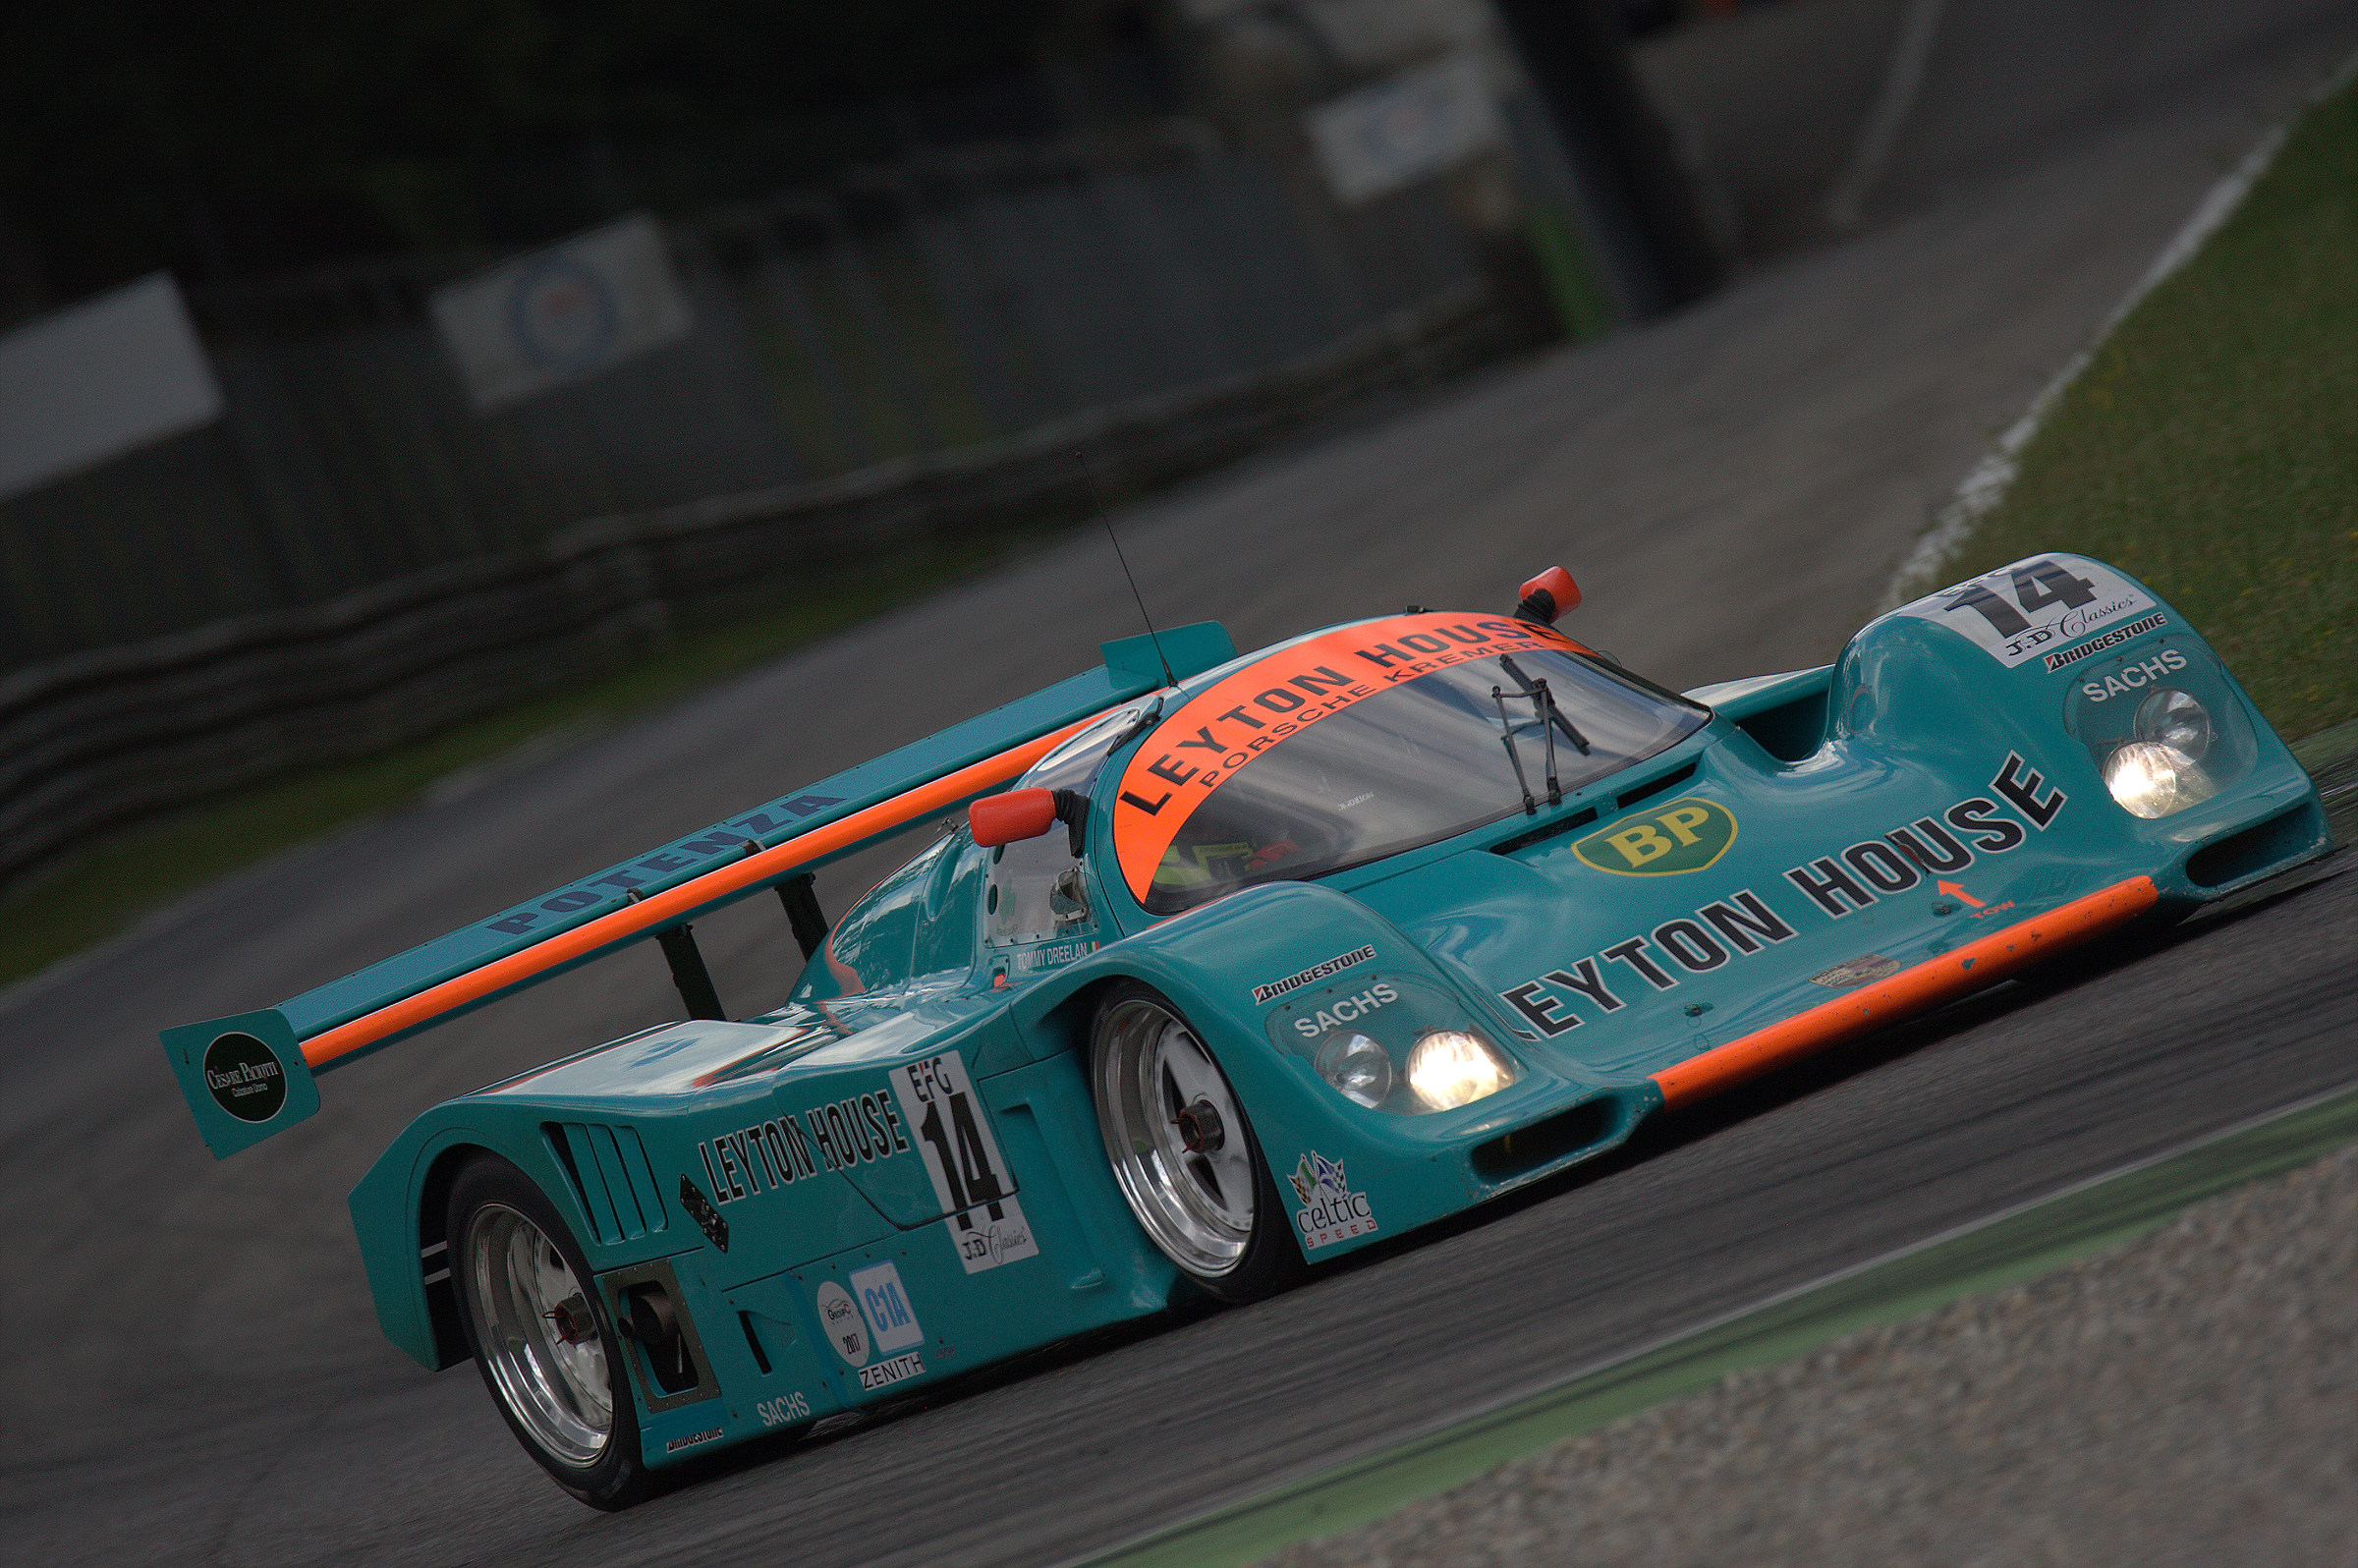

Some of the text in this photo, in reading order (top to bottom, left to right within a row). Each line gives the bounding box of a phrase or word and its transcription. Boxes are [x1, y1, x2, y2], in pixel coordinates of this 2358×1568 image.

[1943, 560, 2098, 640] 14
[2059, 596, 2137, 639] Classics
[2045, 613, 2166, 673] BRIDGESTONE
[2082, 648, 2187, 702] SACHS
[1119, 620, 1569, 816] LEYTON HOUSE
[1198, 641, 1546, 788] PORSCHE KREMER
[1603, 806, 1710, 868] BP
[1782, 749, 2068, 919] HOUSE
[485, 794, 847, 935] POTENZA
[1969, 899, 2015, 919] TOW
[1017, 942, 1088, 971] TOMMY DREELAN
[1253, 945, 1376, 1005] BRIDGESTONE
[1294, 983, 1398, 1037] SACHS
[906, 1056, 953, 1104] EFG
[698, 1089, 911, 1206] LEYTON HOUSE
[921, 1091, 1004, 1232] 14
[1306, 1219, 1376, 1248] SPEED
[864, 1281, 912, 1332] C1A
[842, 1332, 861, 1355] 2017
[860, 1356, 926, 1389] ZENITH
[757, 1390, 811, 1428] SACHS
